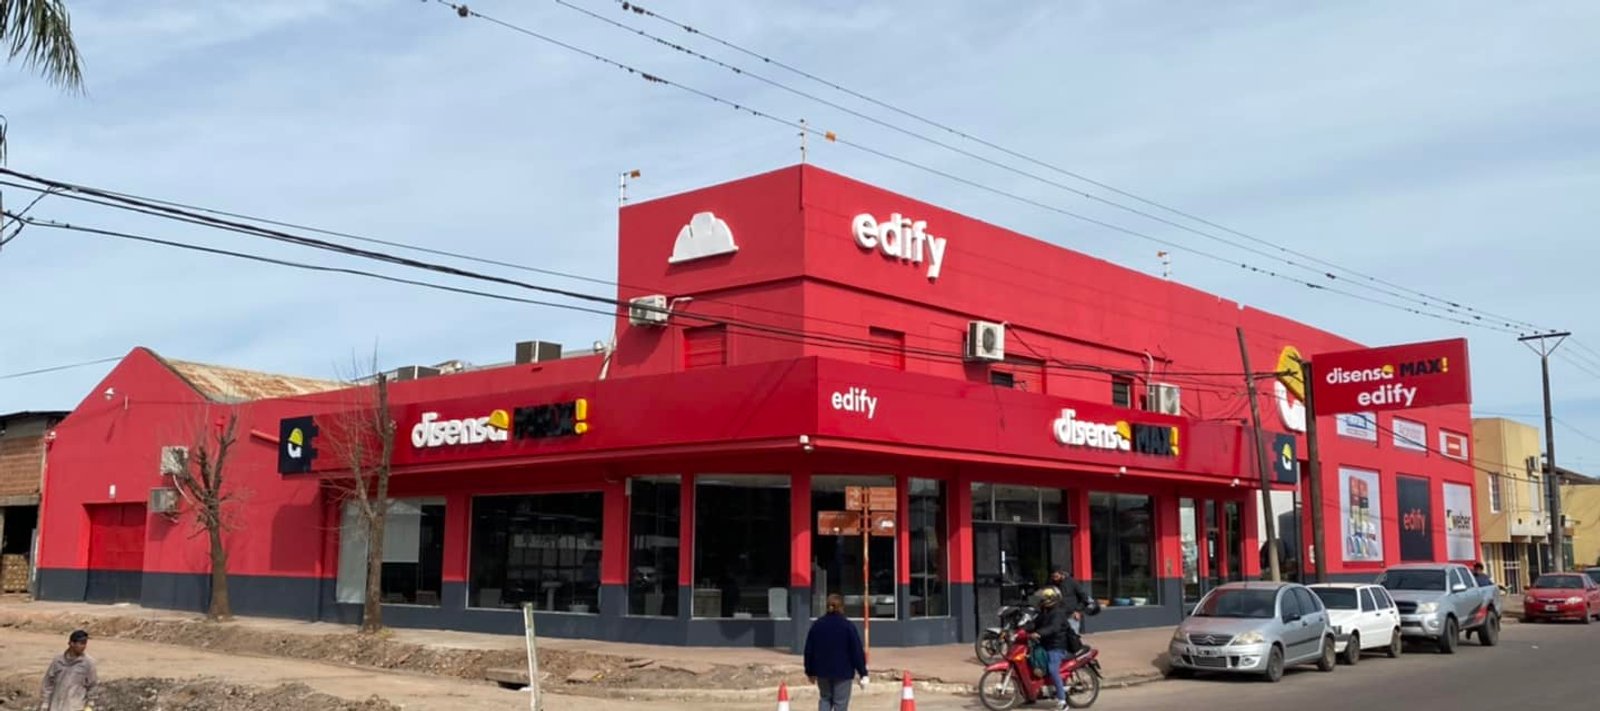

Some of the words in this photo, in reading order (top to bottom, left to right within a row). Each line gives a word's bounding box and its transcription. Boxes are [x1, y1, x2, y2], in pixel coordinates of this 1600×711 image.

[852, 212, 946, 278] edify
[1326, 364, 1394, 384] disensa
[1400, 357, 1448, 376] MAX!
[831, 386, 877, 419] edify
[1357, 383, 1417, 406] edify
[411, 409, 509, 448] disensa
[1053, 408, 1131, 451] disensa
[1133, 423, 1179, 456] MAX!
[1403, 508, 1426, 536] edify
